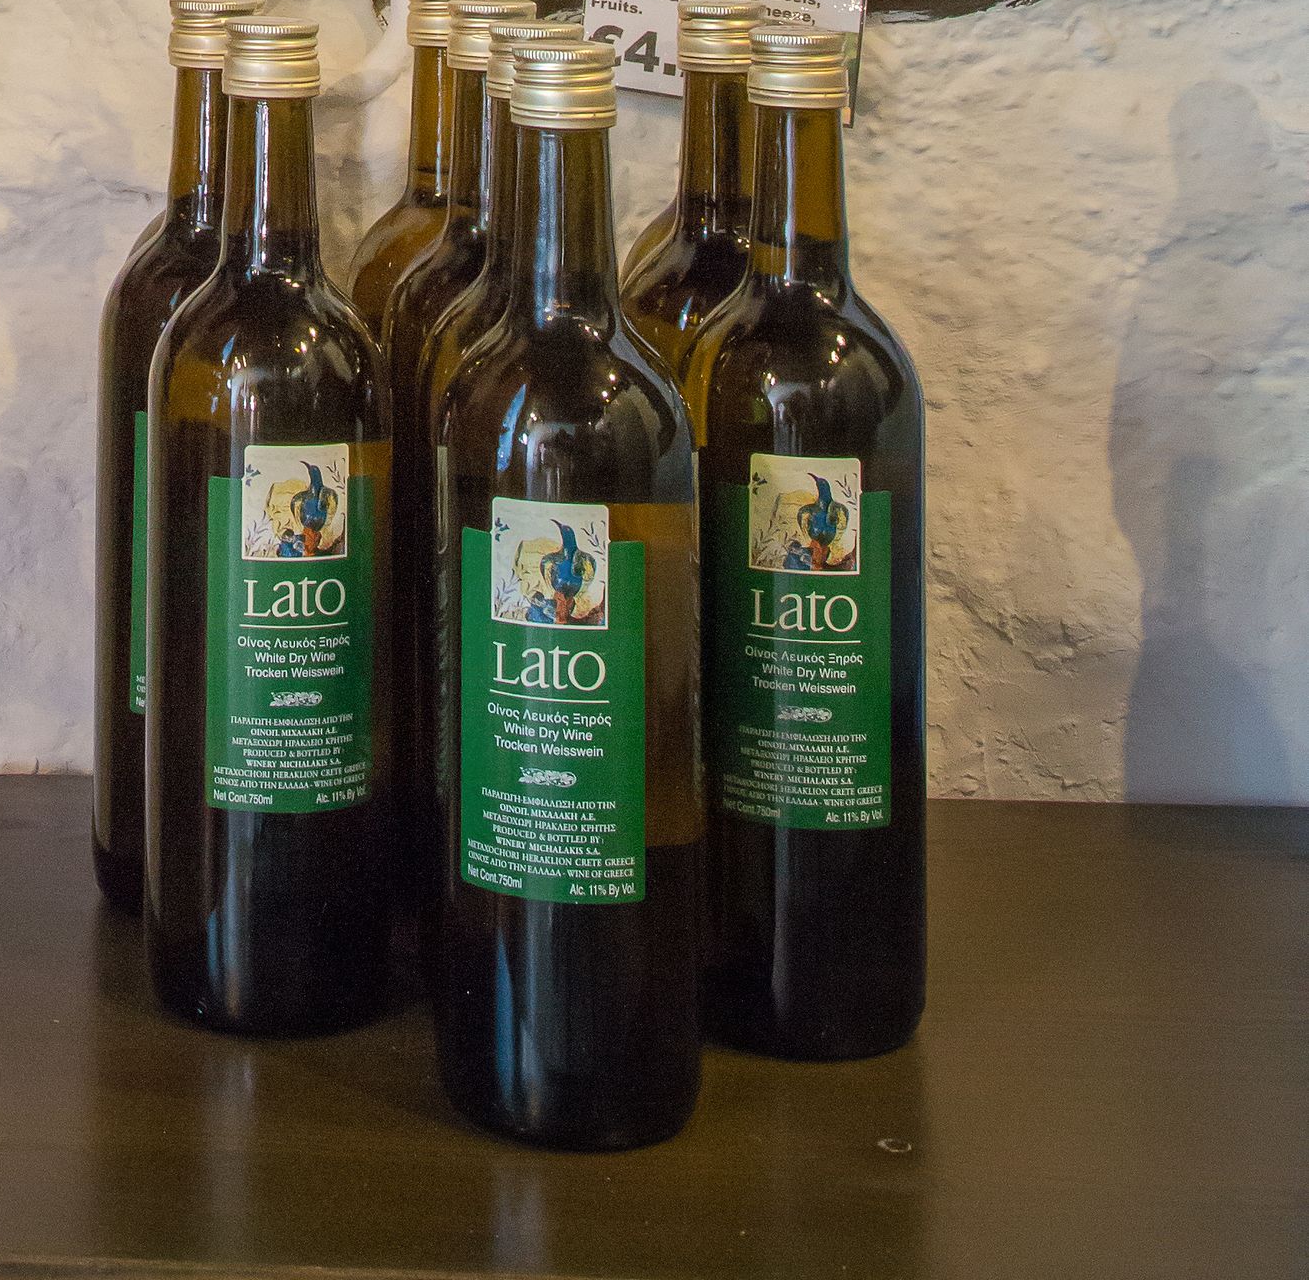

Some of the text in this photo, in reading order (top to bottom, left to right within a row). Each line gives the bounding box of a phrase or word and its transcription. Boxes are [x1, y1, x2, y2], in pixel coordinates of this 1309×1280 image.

[243, 576, 346, 618] Lato
[750, 589, 858, 632] Lato
[237, 634, 350, 650] Οίνος Λευκός Ξηρός
[255, 651, 335, 665] White Dry Wine
[745, 645, 863, 665] Οίνος Λευκός Ξηρός
[245, 665, 344, 678] Trocken Weisswein
[492, 640, 606, 691] Lato
[762, 663, 847, 680] White Dry Wine
[752, 676, 856, 694] Trocken Weisswein
[487, 702, 612, 727] Οίνος Λευκός Ξηρός
[504, 721, 593, 742] White Dry Wine
[243, 748, 286, 758] PRODUCED
[296, 748, 331, 757] BOTTLED
[494, 735, 604, 757] Trocken Weisswein
[245, 758, 277, 768] WINERY
[279, 759, 328, 768] MICHALAKIS
[273, 770, 319, 779] HERAKLION
[788, 776, 839, 785] MICHALAKIS
[213, 789, 227, 800] Net
[316, 794, 330, 804] Alc.
[332, 792, 346, 802] 11%
[830, 788, 855, 796] CRETE
[823, 799, 845, 807] WINE
[845, 799, 856, 807] OF
[826, 812, 841, 823] Alc.
[843, 812, 859, 822] 11%
[860, 811, 870, 824] By
[492, 824, 536, 840] PRODUCED
[539, 833, 546, 841] &
[547, 834, 587, 844] BOTTLED
[495, 836, 526, 849] WINERY
[529, 842, 584, 855] MICHALAKIS
[522, 853, 572, 866] HERAKLION
[575, 858, 602, 867] CRETE
[604, 857, 635, 867] GREECE
[467, 863, 479, 877] Net
[566, 869, 590, 878] WINE
[591, 869, 603, 878] OF
[603, 868, 634, 878] GREECE
[570, 883, 636, 897] Alc. 11% By Vol.
